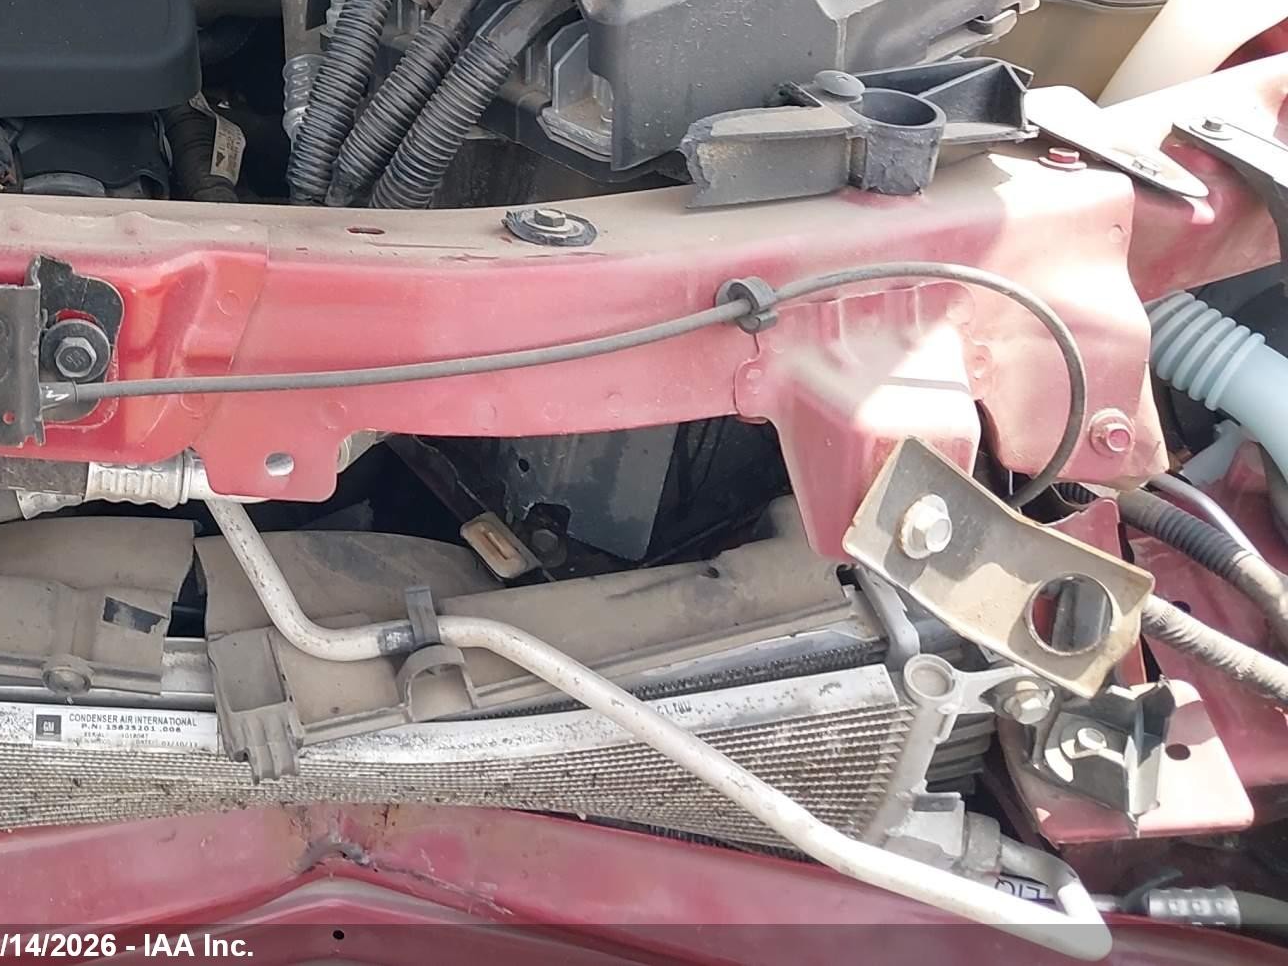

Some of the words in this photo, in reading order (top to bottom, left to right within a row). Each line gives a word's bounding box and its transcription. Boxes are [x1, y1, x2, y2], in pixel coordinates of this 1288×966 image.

[69, 713, 118, 723] CONDENSER
[120, 715, 133, 724] AIR
[135, 716, 197, 727] INTERNATIONAL
